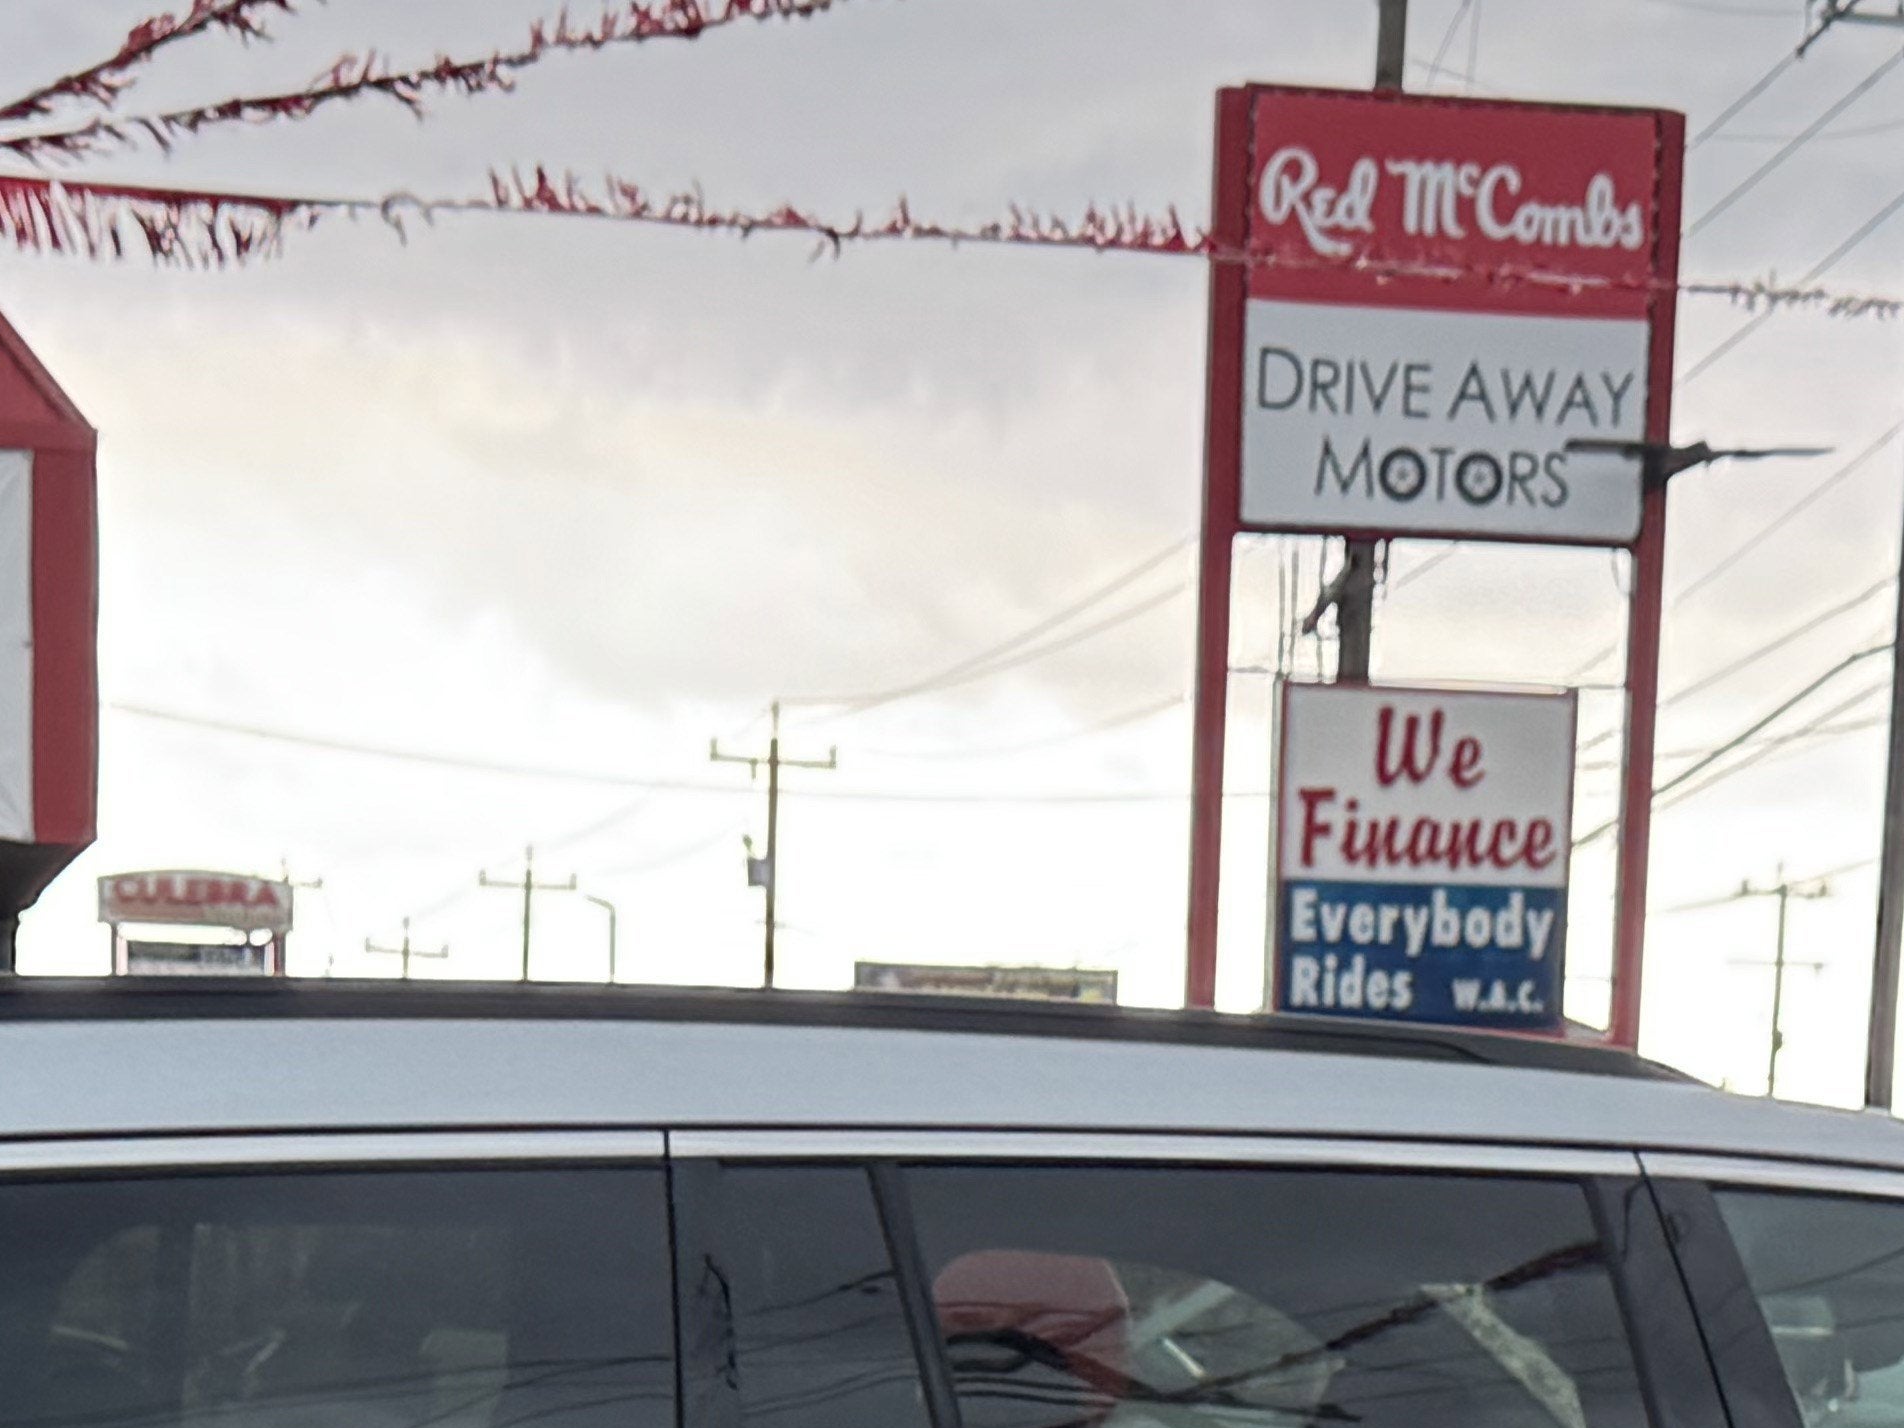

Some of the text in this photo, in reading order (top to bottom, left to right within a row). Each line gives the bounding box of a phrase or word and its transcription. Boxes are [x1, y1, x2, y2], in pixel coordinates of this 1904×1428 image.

[1259, 147, 1644, 255] Red McCombs
[1257, 347, 1634, 428] DRIVE AWAY
[1314, 435, 1571, 509] MOTORS
[1374, 705, 1486, 790] We
[1297, 787, 1556, 871] Finance
[1290, 887, 1555, 960] Everybody
[1289, 953, 1414, 1011] Rides
